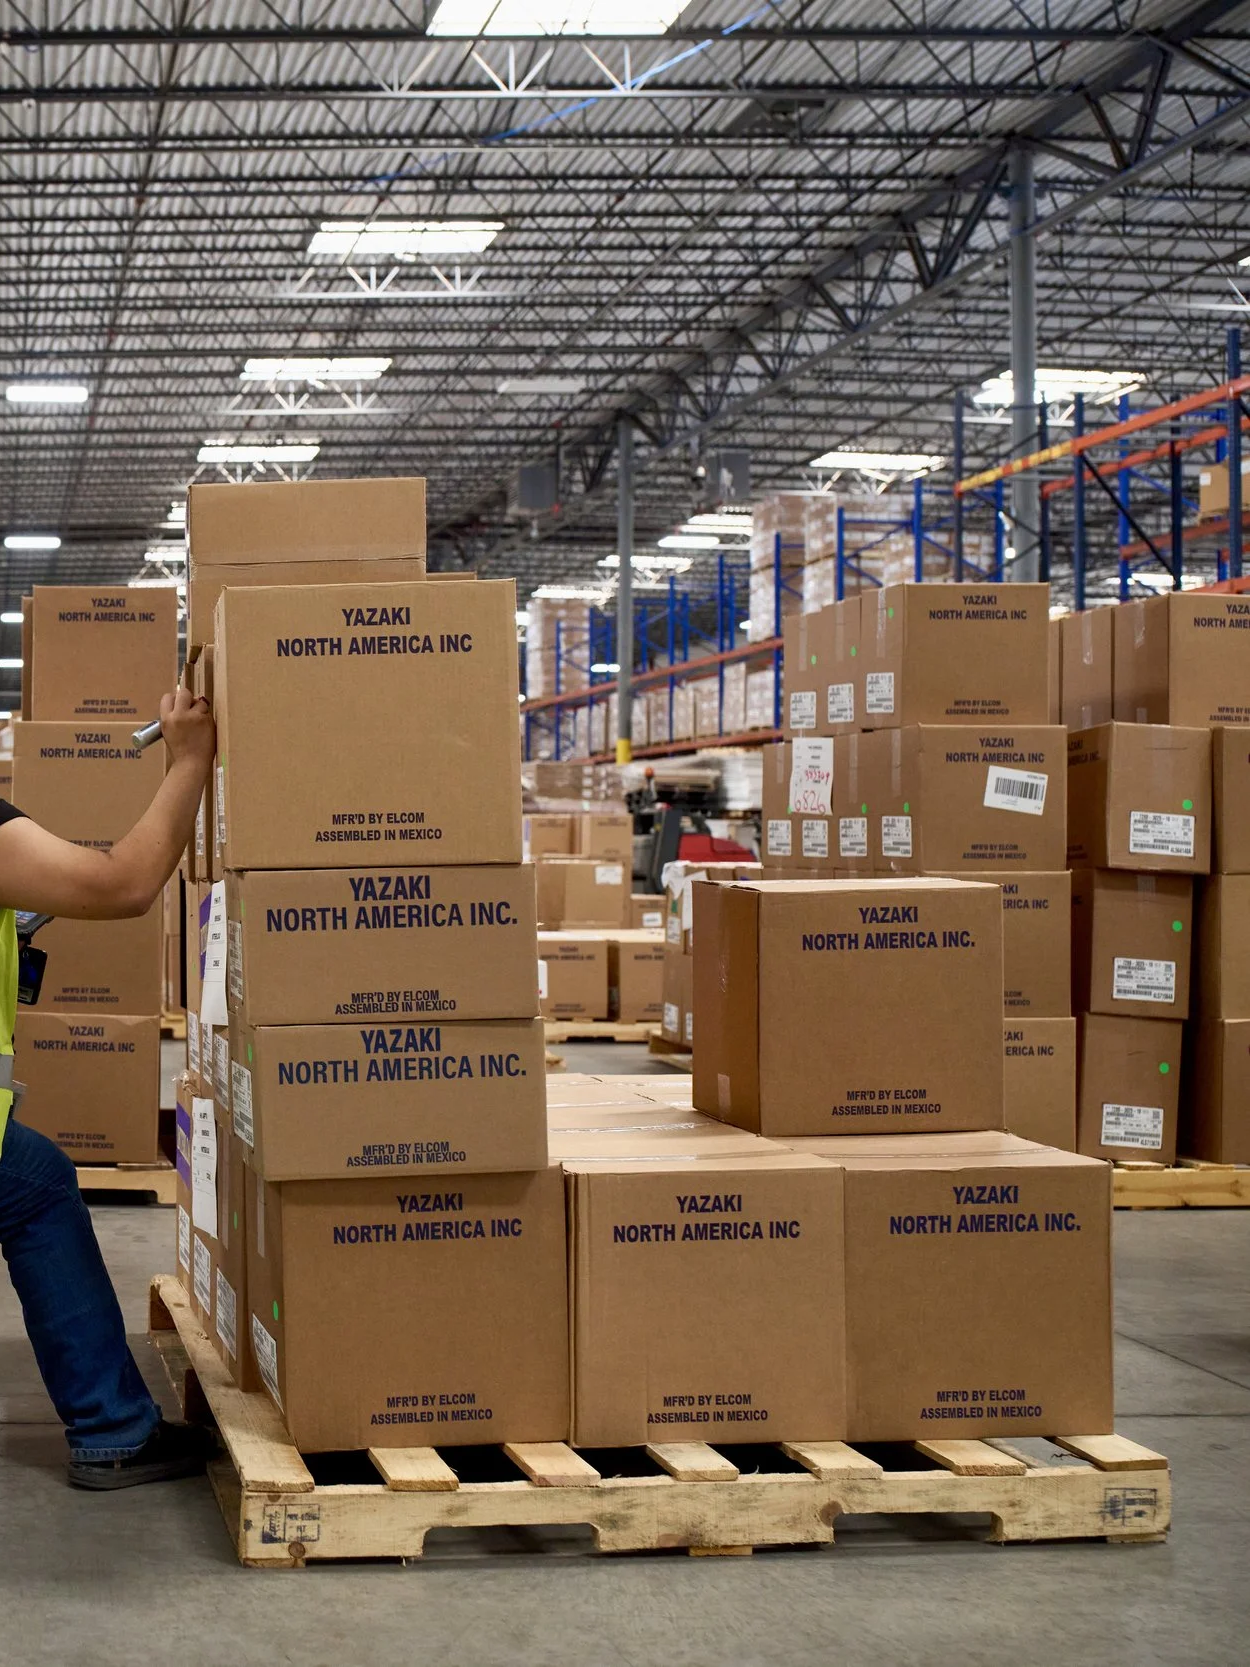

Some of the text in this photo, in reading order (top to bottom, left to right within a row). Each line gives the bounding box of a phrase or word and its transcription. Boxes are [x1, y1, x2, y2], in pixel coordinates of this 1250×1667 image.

[92, 598, 125, 608] YAZAKI
[963, 595, 997, 605] YAZAKI
[59, 612, 155, 622] NORTH AMERICA INC
[342, 607, 410, 626] YAZAKI
[929, 610, 1026, 620] NORTH AMERICA INC
[1194, 618, 1225, 627] NORTH
[277, 634, 472, 656] NORTH AMERICA INC
[75, 734, 110, 743] YAZAKI
[979, 738, 1013, 747] YAZAKI
[41, 748, 142, 759] NORTH AMERICA INC
[946, 752, 1044, 763] NORTH AMERICA INC
[333, 813, 424, 825] MFR'D BY ELCOM
[315, 827, 442, 842] ASSEMBLED IN MEXICO
[349, 875, 430, 901] YAZAKI
[1032, 899, 1048, 909] INC
[267, 902, 517, 932] NORTH AMERICA INC.
[859, 907, 918, 923] YAZAKI
[803, 931, 975, 950] NORTH AMERICA INC.
[350, 990, 441, 1003] MFR'D BY ELCOM
[335, 1000, 456, 1014] ASSEMBLED IN MEXICO
[68, 1026, 104, 1037] YAZAKI
[34, 1040, 134, 1052] NORTH AMERICA INC
[360, 1028, 443, 1054] YAZAKI
[1038, 1046, 1054, 1055] INC
[279, 1054, 526, 1084] NORTH AMERICA INC.
[847, 1089, 926, 1100] MFR'D BY ELCOM
[832, 1104, 941, 1116] ASSEMBLED IN MEXICO
[361, 1142, 449, 1156] MFR'D BY ELCOM
[347, 1152, 466, 1167] ASSEMBLED IN MEXICO
[953, 1186, 1018, 1204] YAZAKI
[396, 1193, 463, 1213] YAZAKI
[677, 1195, 741, 1213] YAZAKI
[890, 1213, 1080, 1234] NORTH AMERICA INC.
[334, 1218, 522, 1244] NORTH AMERICA INC
[614, 1221, 800, 1242] NORTH AMERICA INC
[387, 1393, 475, 1408] MFR'D BY ELCOM
[664, 1394, 751, 1407] MFR'D BY ELCOM
[937, 1390, 1025, 1402] MFR'D BY ELCOM
[371, 1409, 492, 1424] ASSEMBLED IN MEXICO
[647, 1408, 768, 1423] ASSEMBLED IN MEXICO
[921, 1406, 1041, 1419] ASSEMBLED IN MEXICO
